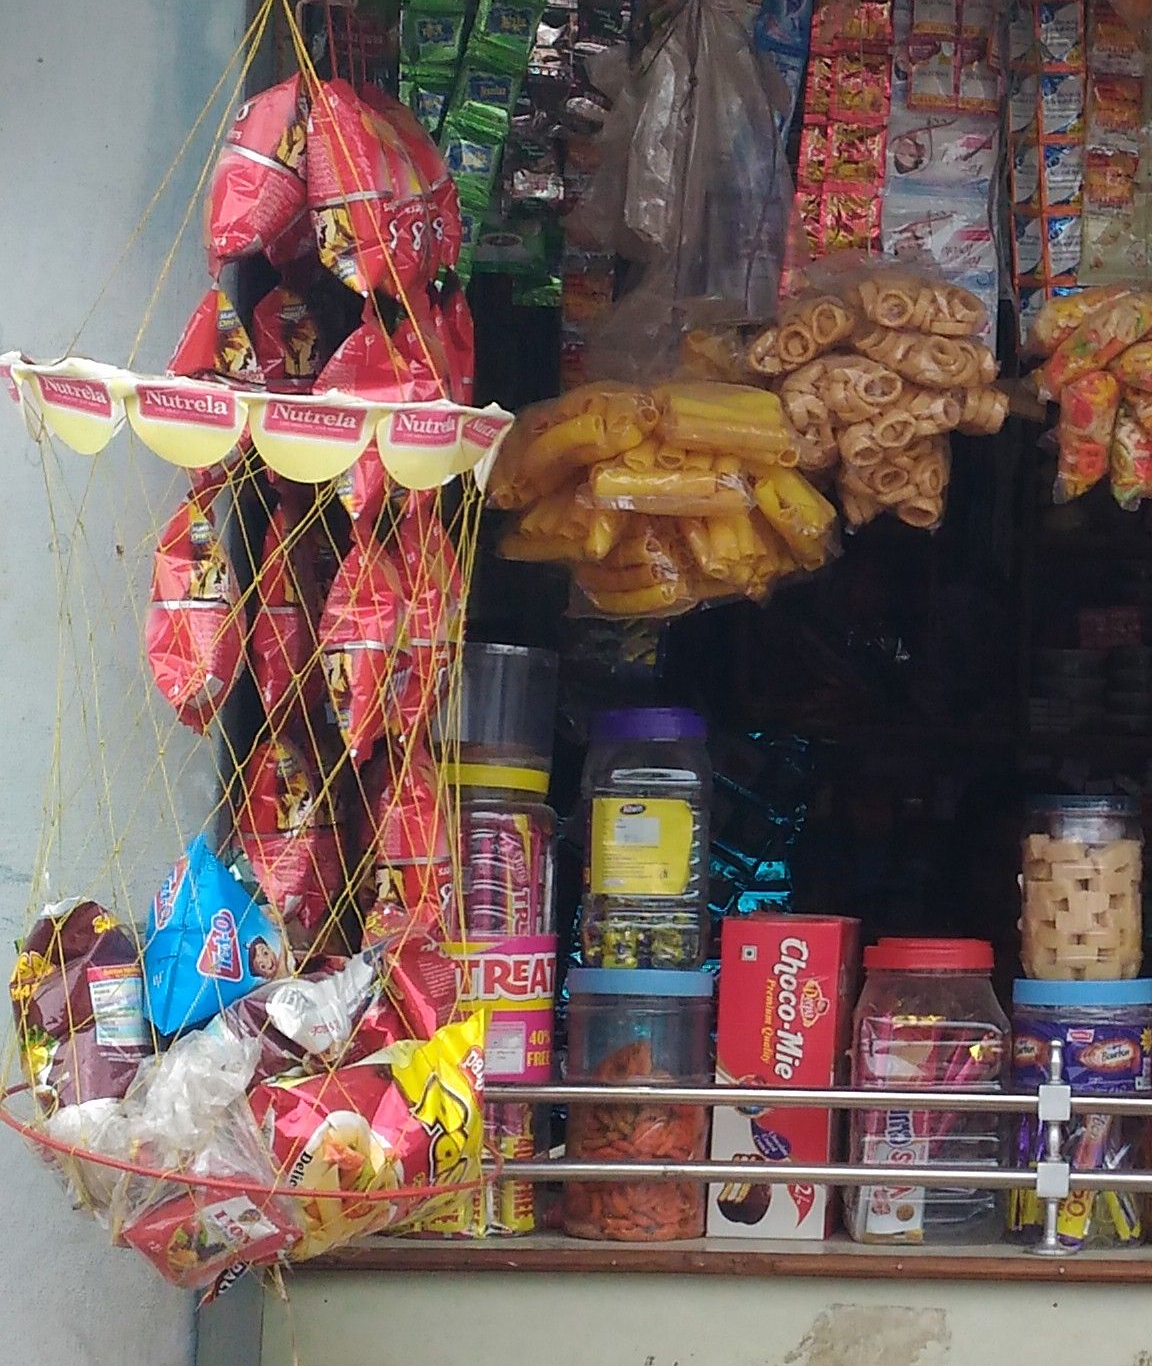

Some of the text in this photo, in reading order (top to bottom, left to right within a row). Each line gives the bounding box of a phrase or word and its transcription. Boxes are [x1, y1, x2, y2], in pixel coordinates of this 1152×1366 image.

[42, 377, 109, 406] Nutrela
[144, 389, 229, 417] Nutrela
[271, 402, 359, 431] Nutrela
[760, 978, 778, 1065] Premium Quality
